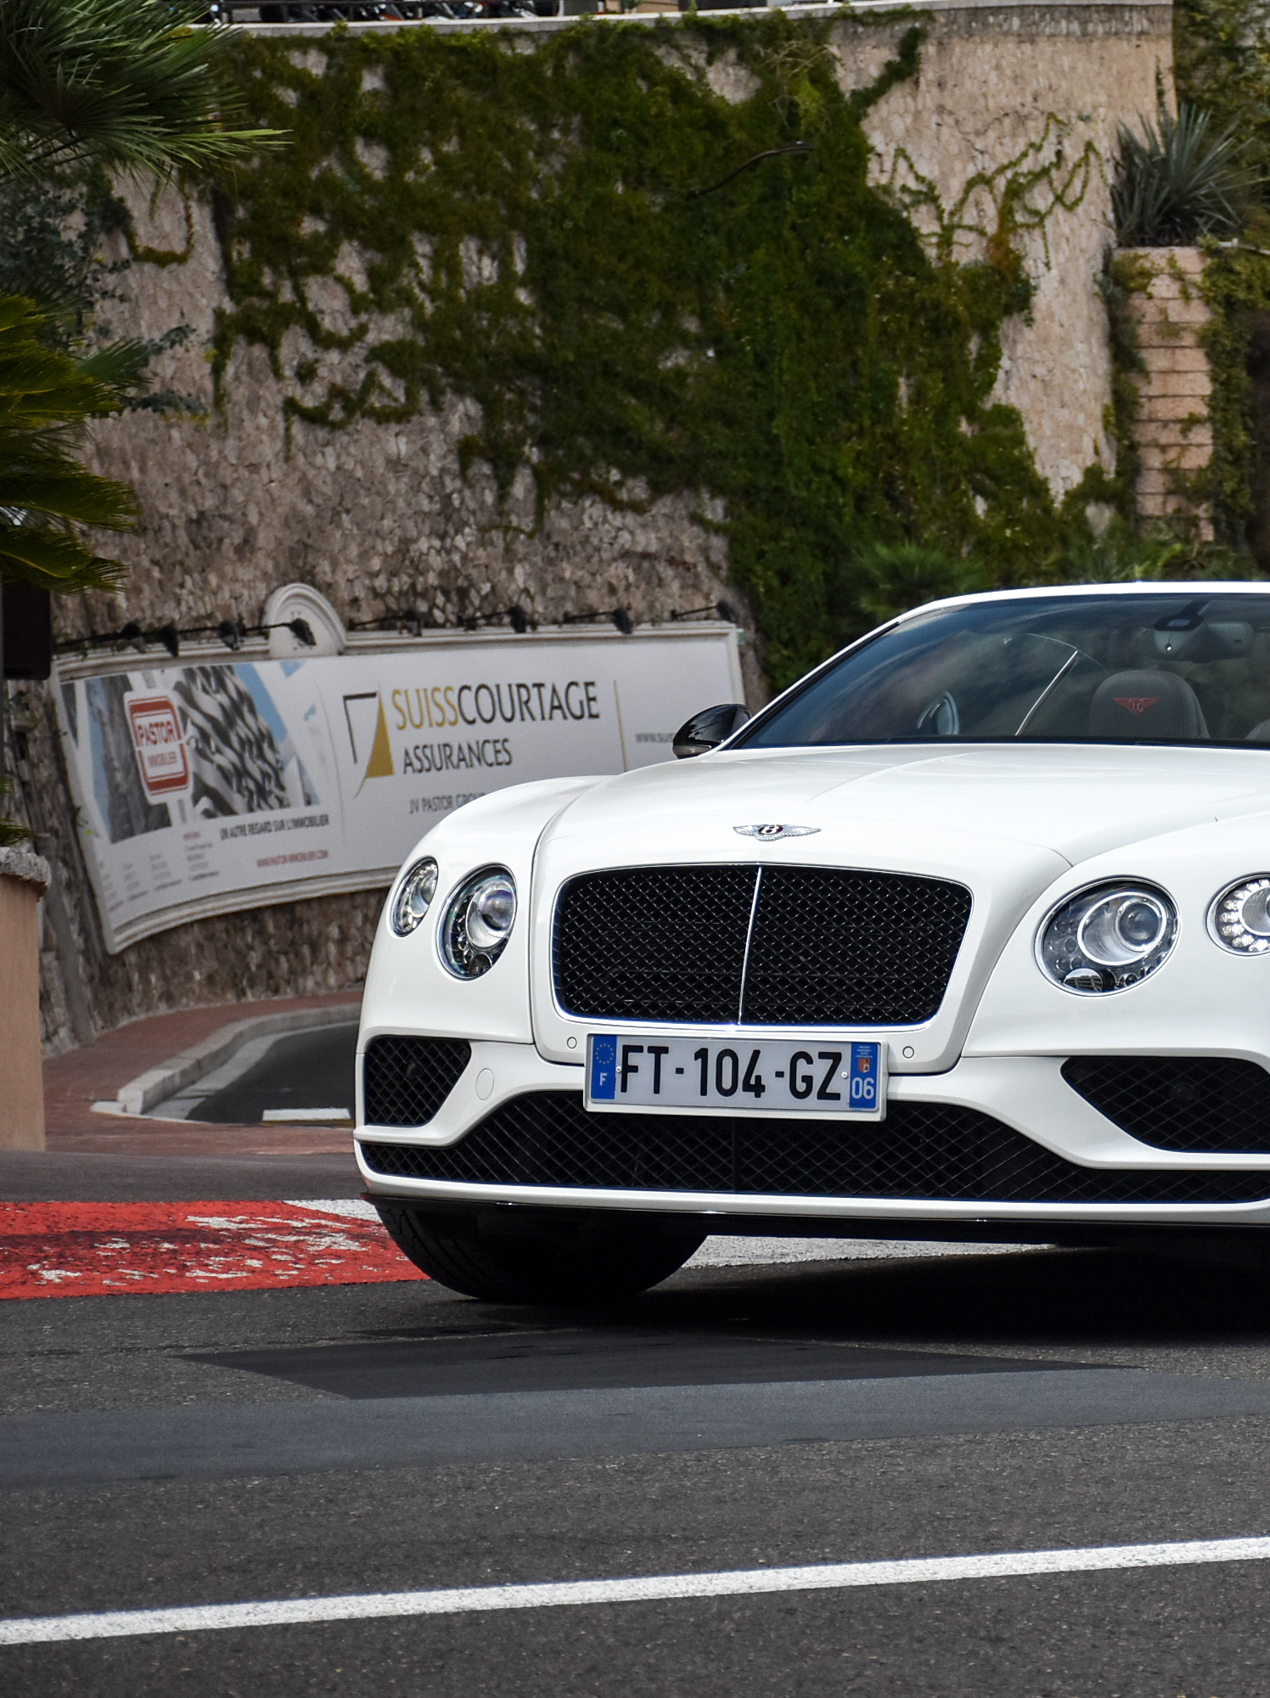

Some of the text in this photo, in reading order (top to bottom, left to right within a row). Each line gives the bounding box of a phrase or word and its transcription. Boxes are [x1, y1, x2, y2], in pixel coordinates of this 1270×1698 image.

[392, 681, 600, 731] SUISSCOURTAGE
[137, 721, 176, 747] PASTOR
[403, 738, 513, 775] ASSURANCES
[599, 1072, 608, 1086] F
[620, 1044, 843, 1101] FT-104-GZ
[851, 1077, 875, 1100] 06
